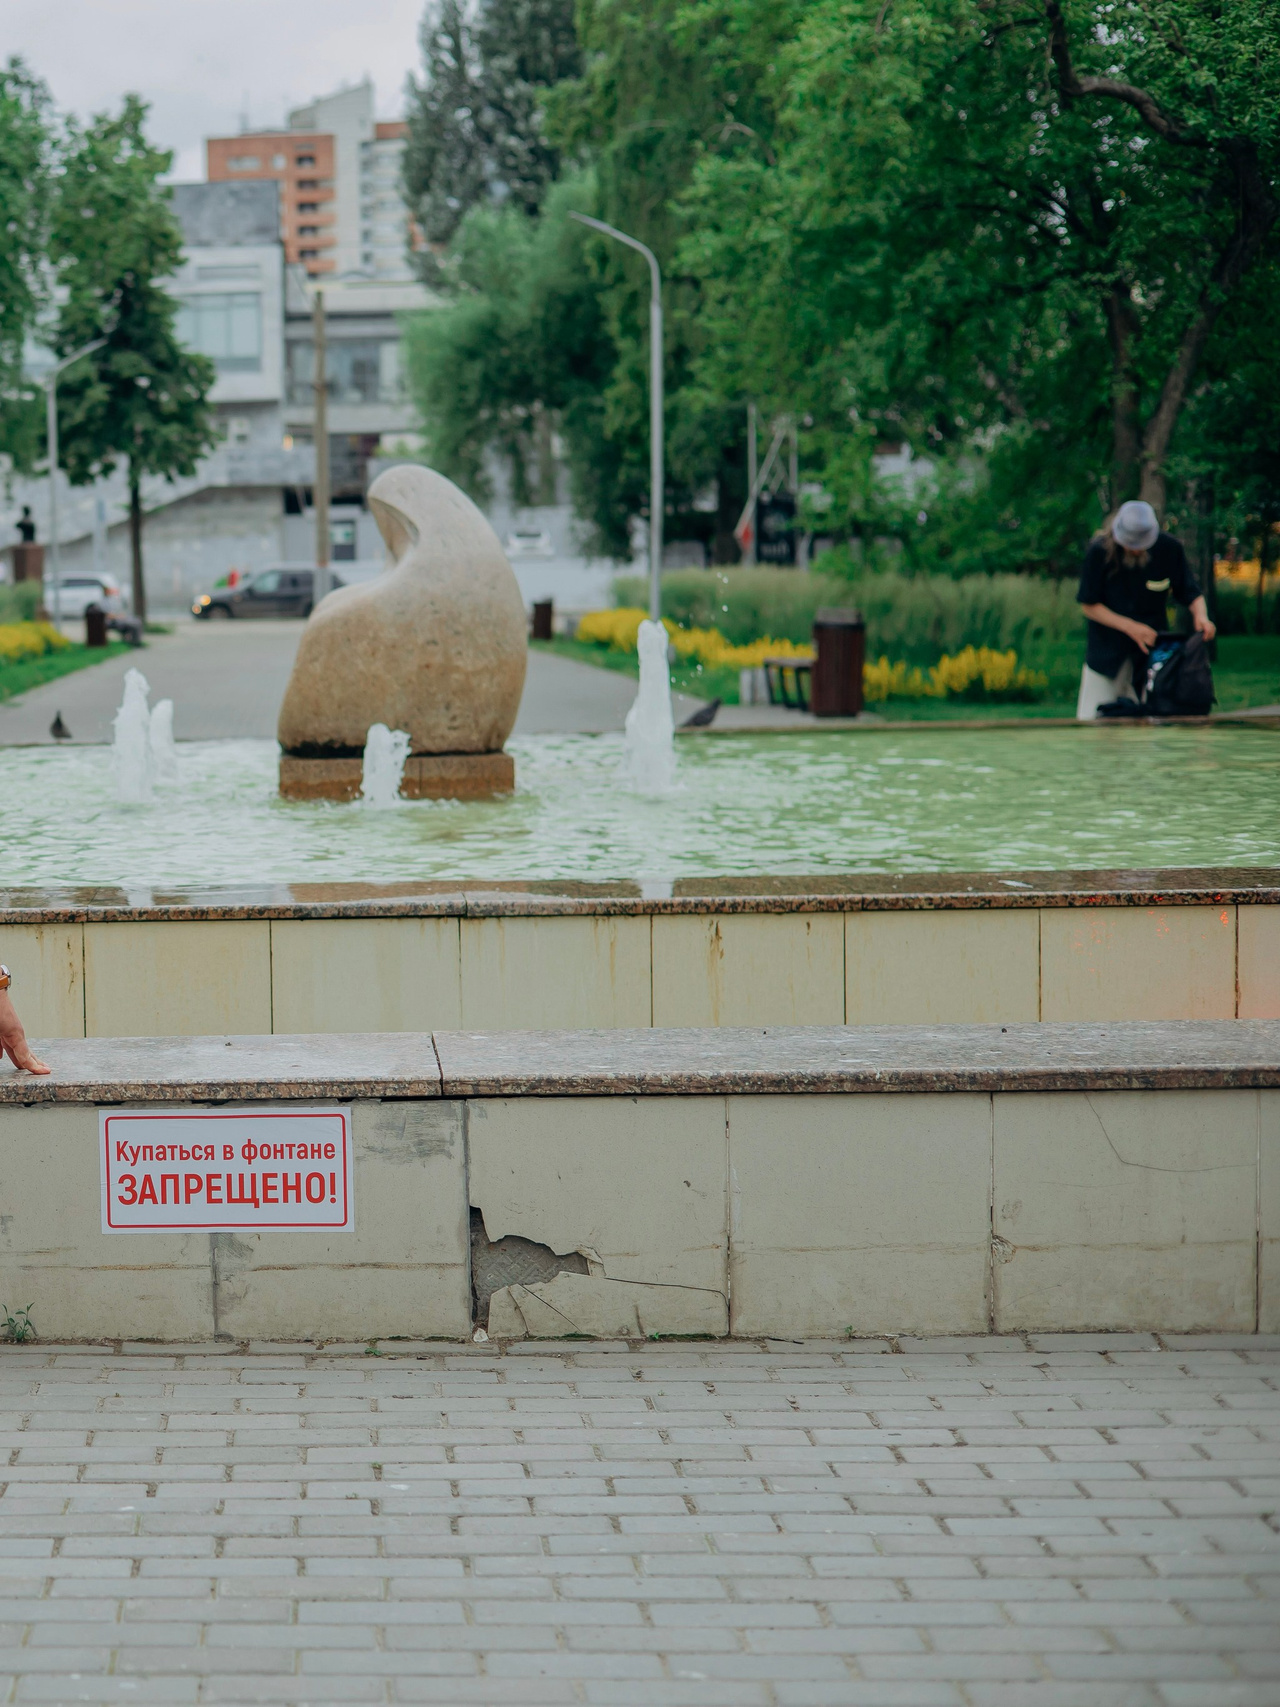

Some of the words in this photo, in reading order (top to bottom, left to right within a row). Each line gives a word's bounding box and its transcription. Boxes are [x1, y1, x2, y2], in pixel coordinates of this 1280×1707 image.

[116, 1140, 215, 1166] Купаться
[223, 1144, 234, 1161] в
[241, 1139, 336, 1165] фонтане
[117, 1172, 337, 1208] ЗАПРЕЩЕНО!
